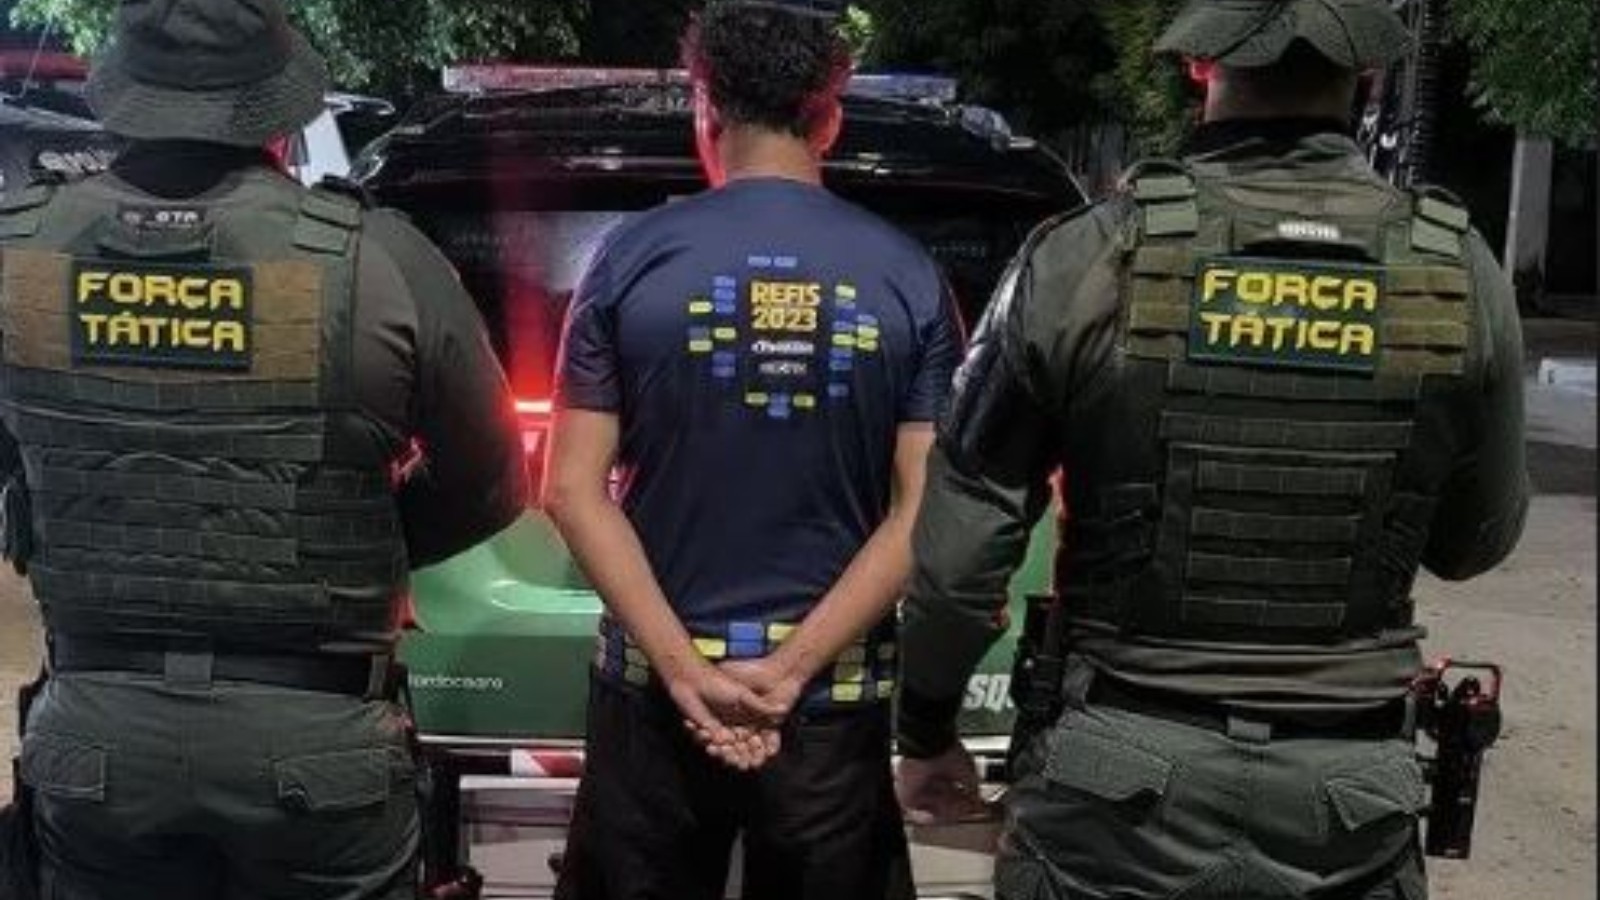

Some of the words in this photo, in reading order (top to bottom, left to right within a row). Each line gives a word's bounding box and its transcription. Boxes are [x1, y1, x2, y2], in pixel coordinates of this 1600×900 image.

[78, 271, 244, 310] FORÇA
[750, 281, 821, 306] REFIS
[1203, 267, 1378, 311] FORÇA
[79, 310, 244, 352] TÁTICA
[751, 307, 818, 333] 2023
[1200, 309, 1374, 355] TÁTICA
